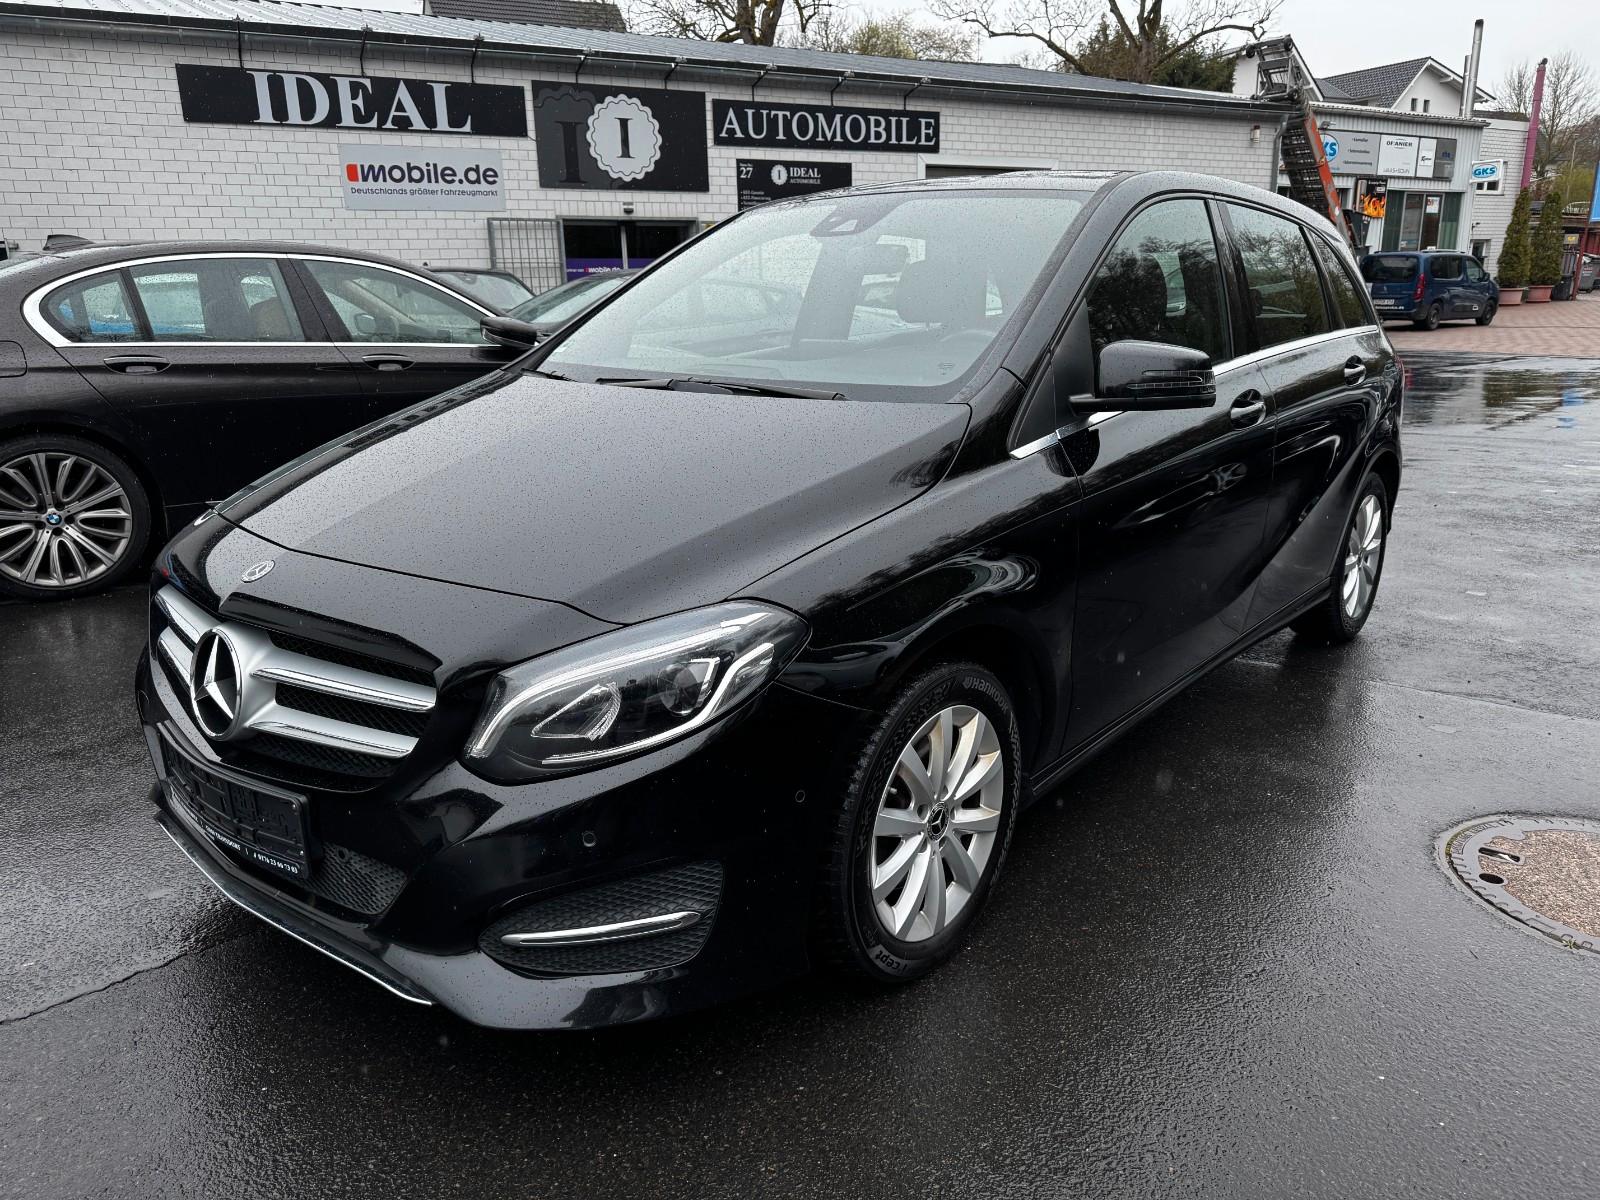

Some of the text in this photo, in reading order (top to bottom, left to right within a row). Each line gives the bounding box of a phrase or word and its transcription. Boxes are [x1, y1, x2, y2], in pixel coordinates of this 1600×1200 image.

[247, 71, 472, 133] IDEAL
[719, 108, 936, 146] AUTOMOBILE
[614, 117, 636, 159] I
[360, 162, 499, 185] mobile.de
[740, 167, 753, 179] 27
[789, 167, 821, 178] IDEAL
[1473, 167, 1496, 176] GKS
[350, 186, 499, 197] Deutschlands größter Fahrzeugmarkt
